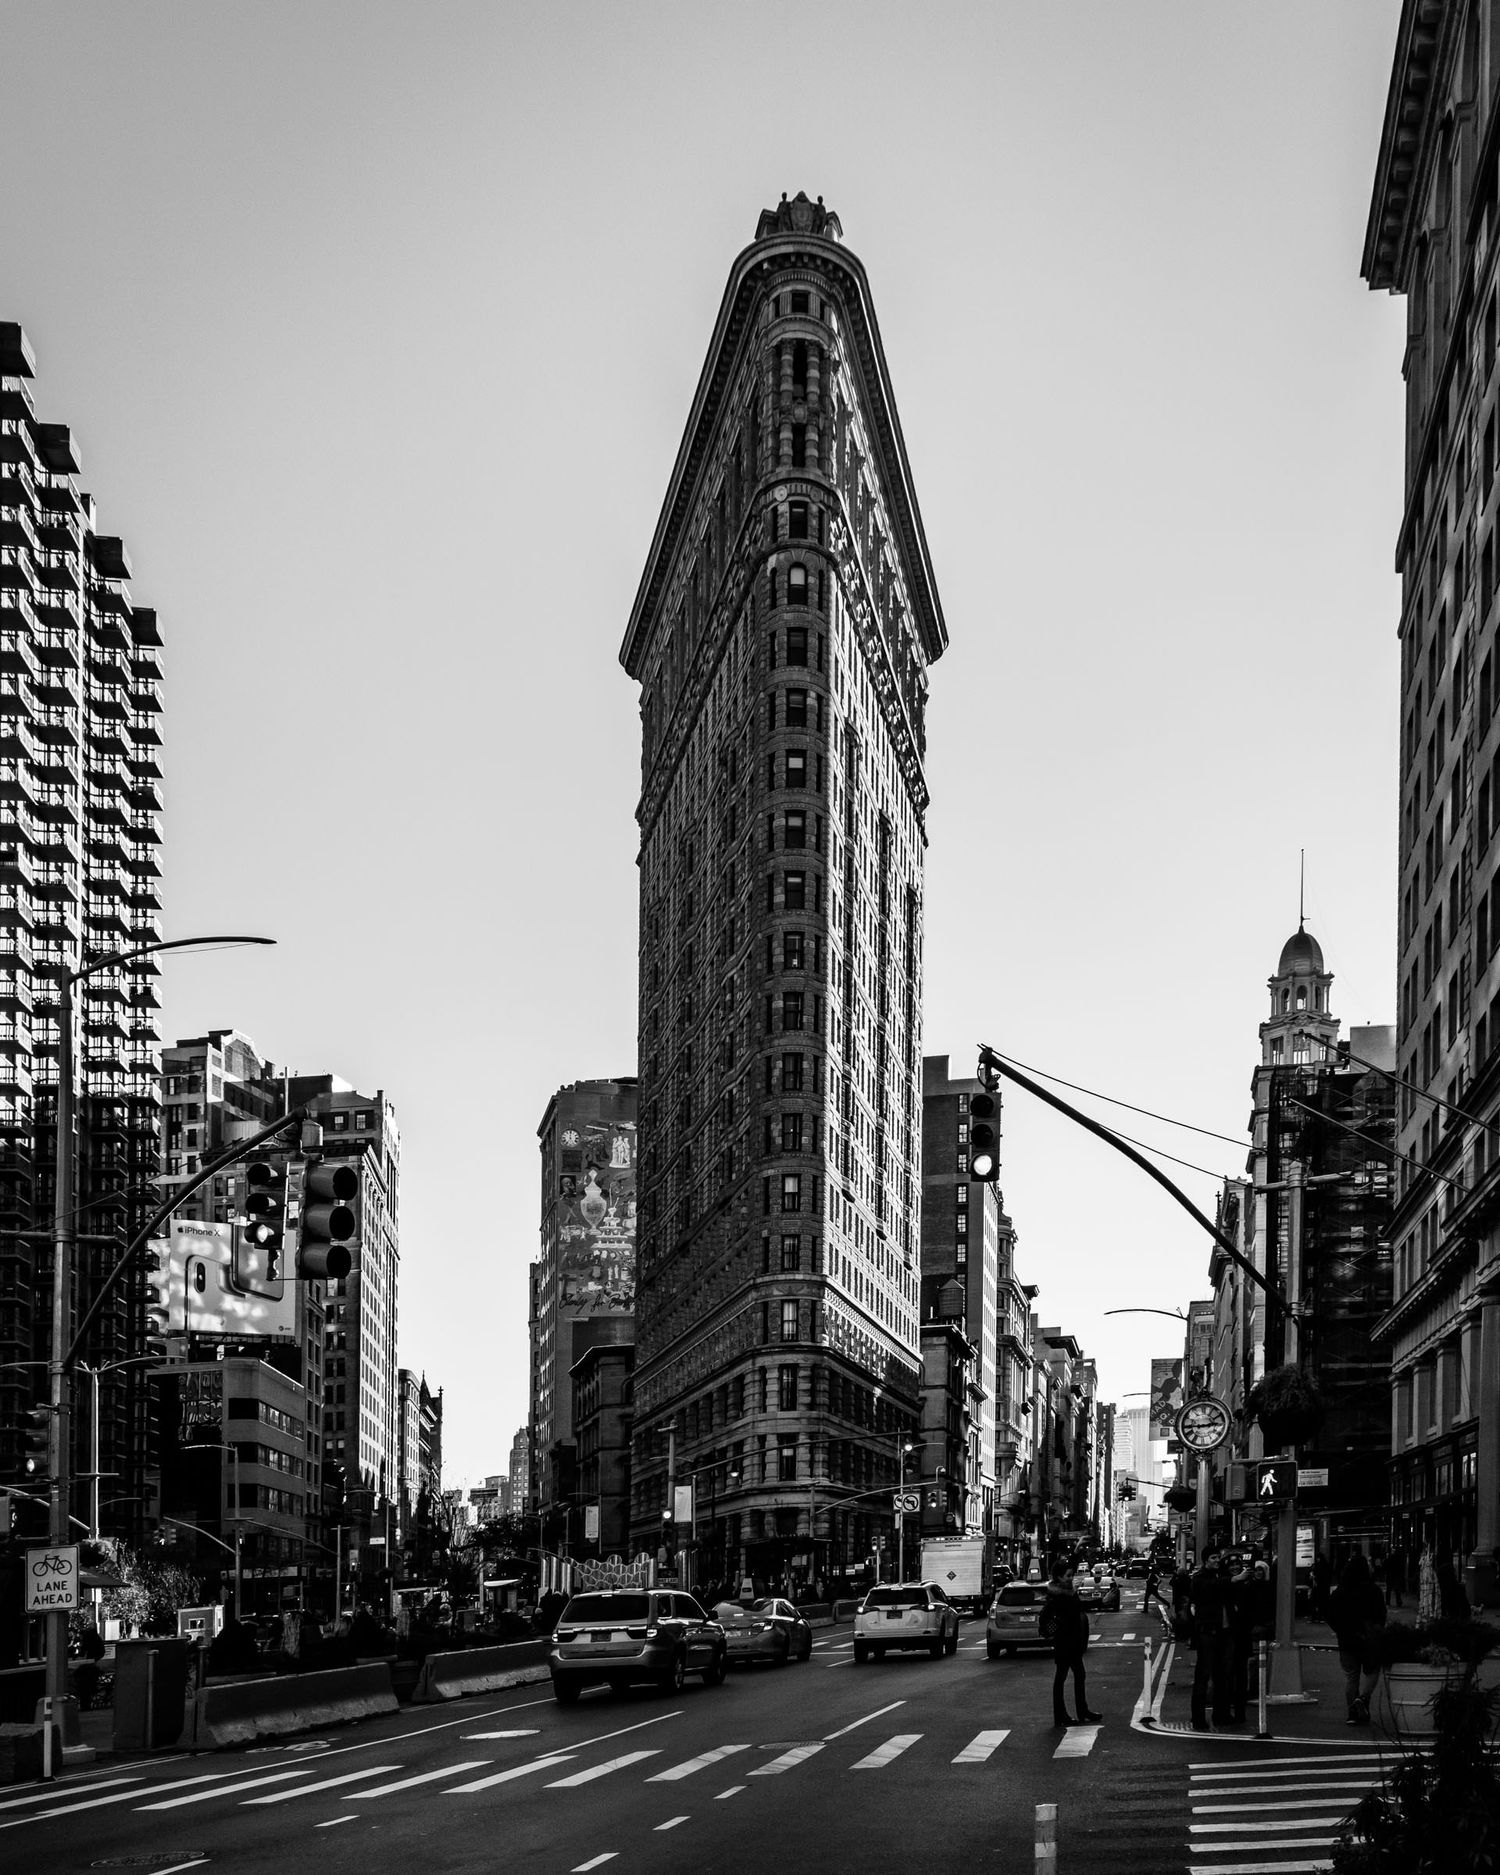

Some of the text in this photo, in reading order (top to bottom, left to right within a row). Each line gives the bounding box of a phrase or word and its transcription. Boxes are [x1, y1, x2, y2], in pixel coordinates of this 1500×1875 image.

[185, 1226, 220, 1237] iPhone X
[37, 1581, 68, 1592] LANE
[33, 1593, 72, 1605] AHEAD
